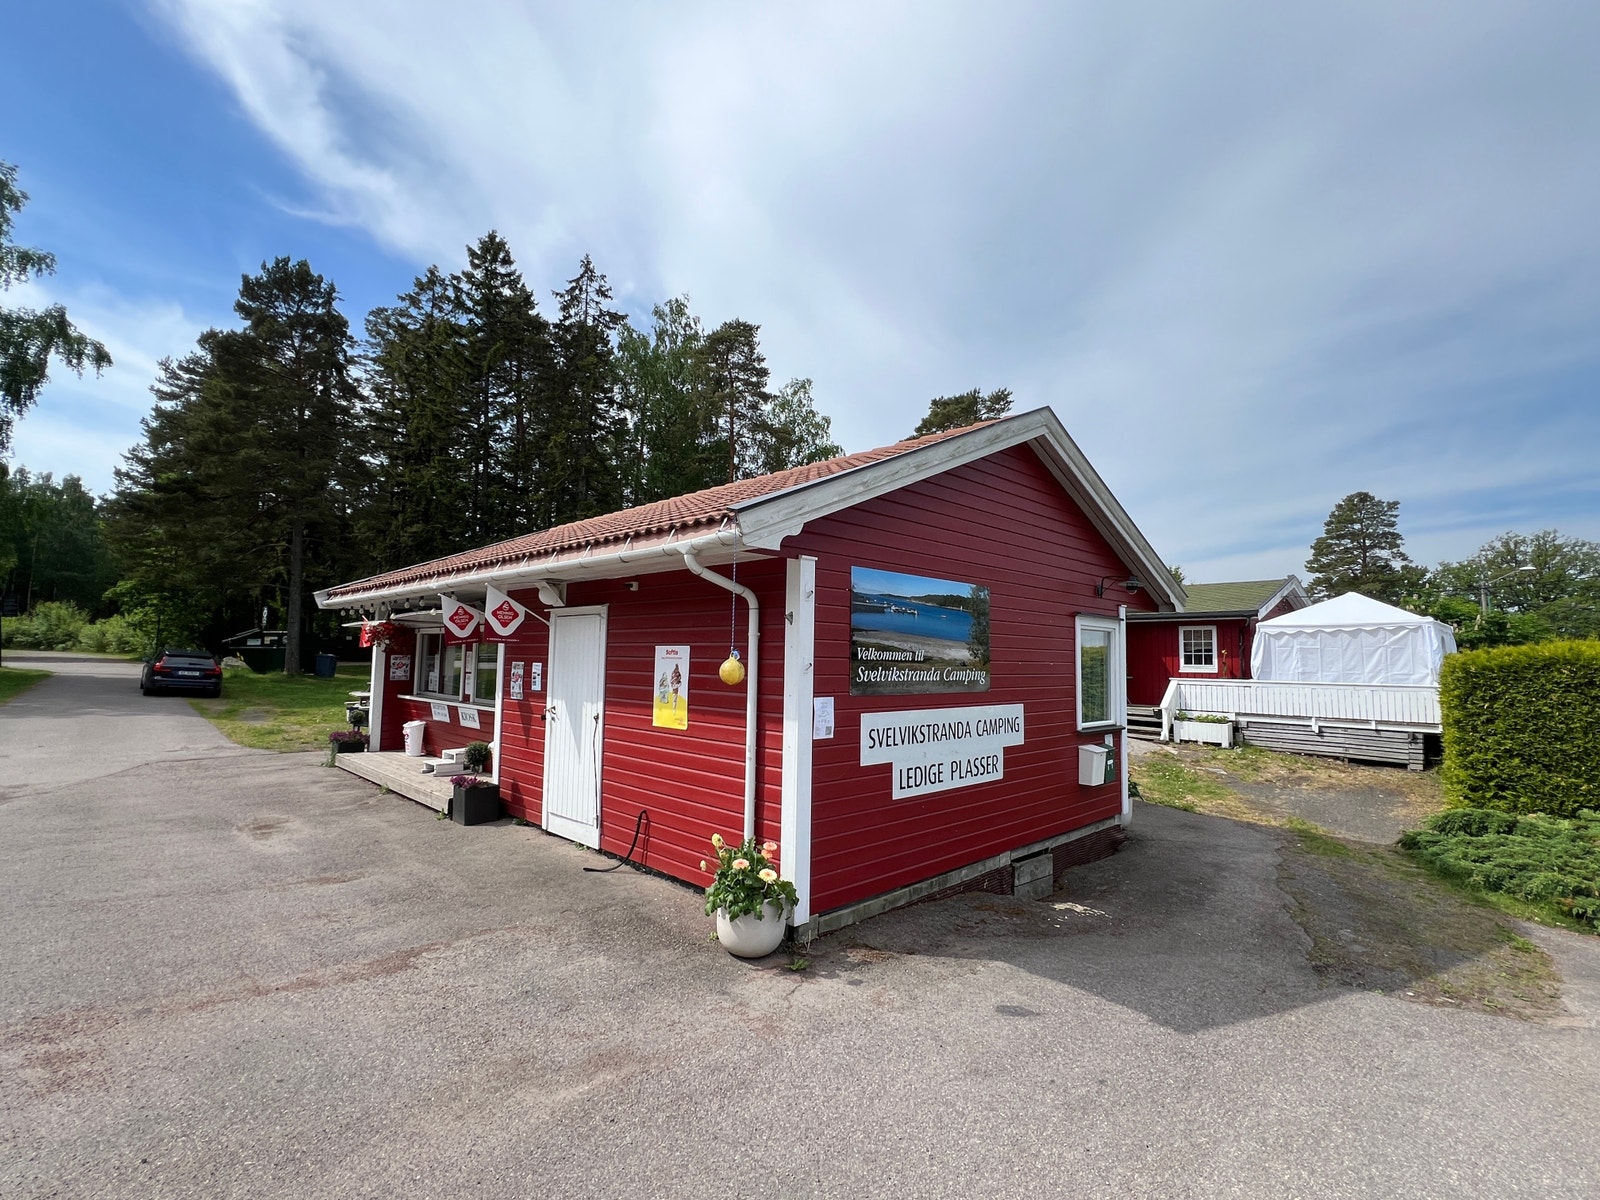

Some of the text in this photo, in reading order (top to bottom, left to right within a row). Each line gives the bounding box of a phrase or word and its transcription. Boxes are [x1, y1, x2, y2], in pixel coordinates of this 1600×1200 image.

[857, 647, 925, 662] Velkommen til
[856, 666, 986, 684] Svelvikstranda Camping
[461, 711, 477, 723] KIOSK
[868, 716, 1020, 749] SVELVIKSTRANDA CAMPING
[899, 754, 999, 790] LEDIGE PLASSER
